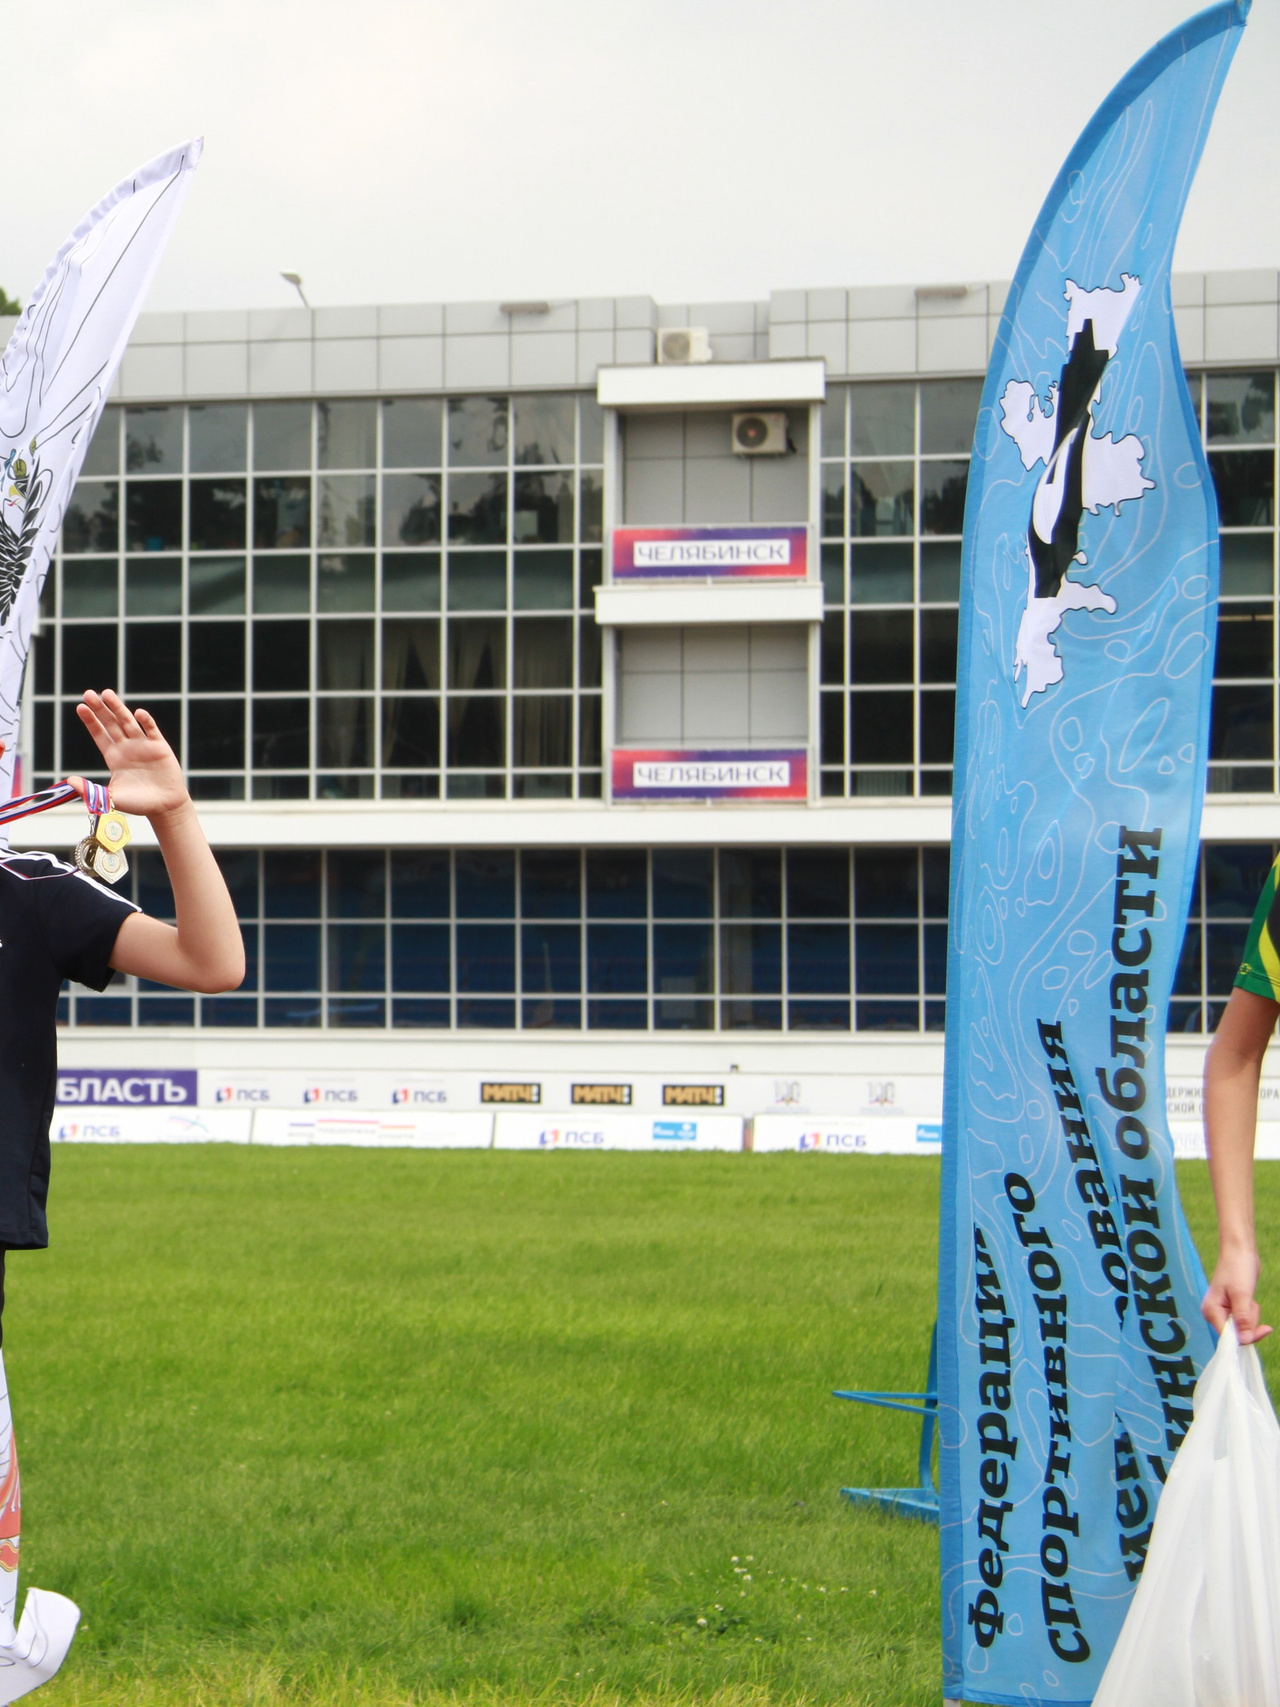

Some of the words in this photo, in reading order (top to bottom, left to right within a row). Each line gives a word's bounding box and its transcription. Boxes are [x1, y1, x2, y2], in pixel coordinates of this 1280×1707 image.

[638, 544, 785, 561] ЧЕЛЯБИНСК
[637, 766, 785, 782] ЧЕЛЯБИНСК
[1095, 825, 1163, 1161] области
[56, 1077, 188, 1103] БЛАСТЬ
[236, 1089, 270, 1102] ПСБ
[324, 1089, 358, 1102] ПСБ
[413, 1090, 447, 1103] ПСБ
[565, 1131, 604, 1144] ПСБ
[826, 1134, 867, 1148] ПСБ
[1004, 1172, 1091, 1663] спортивного
